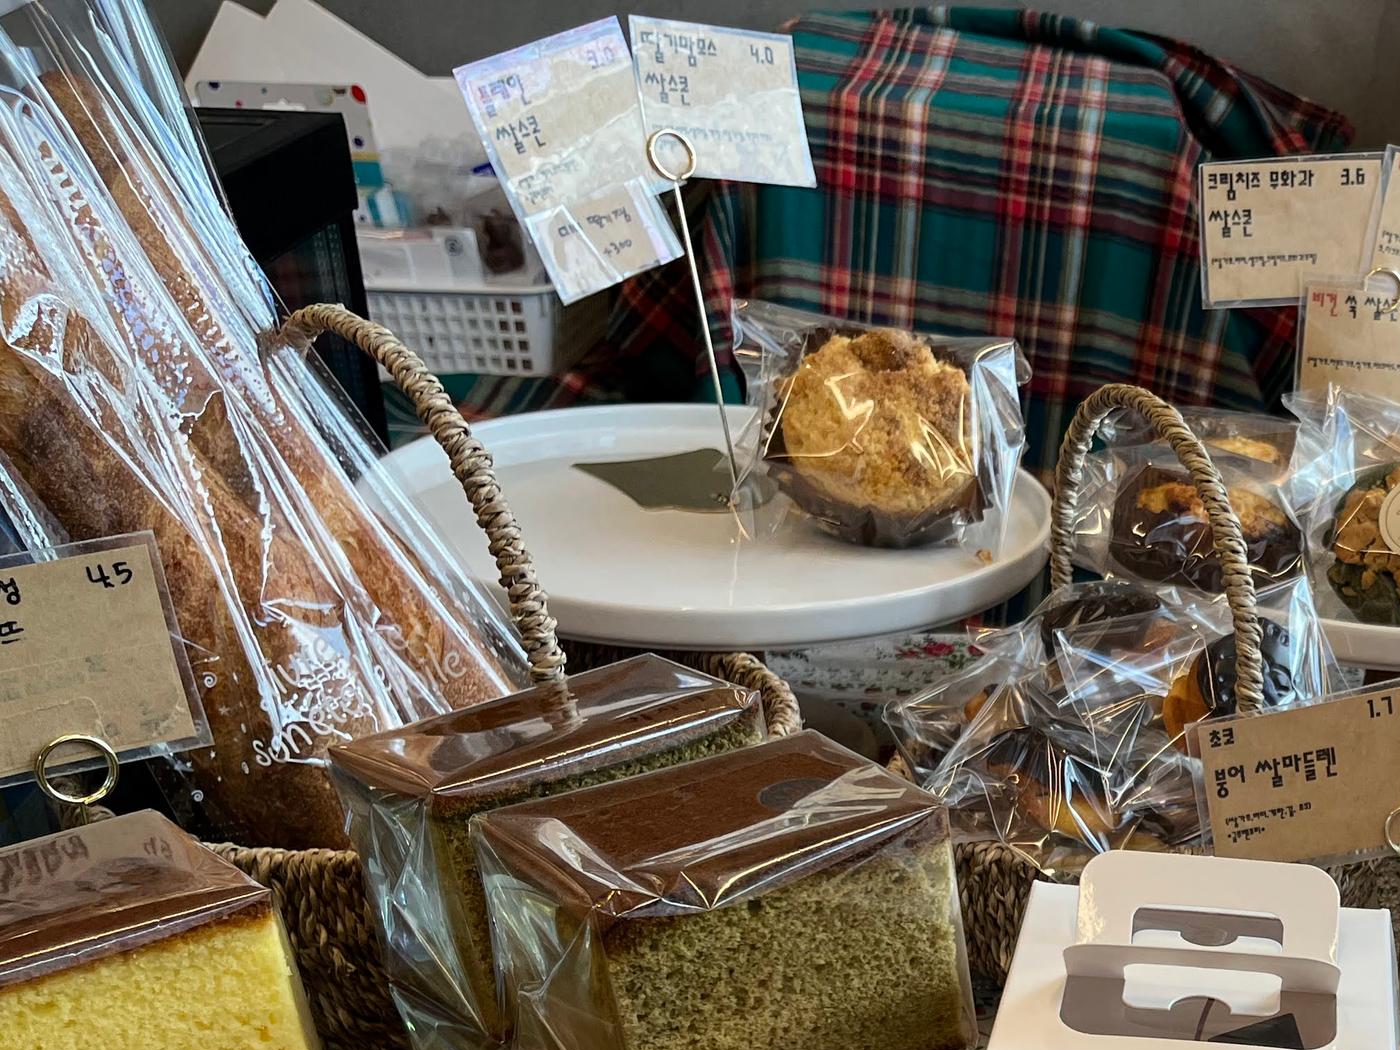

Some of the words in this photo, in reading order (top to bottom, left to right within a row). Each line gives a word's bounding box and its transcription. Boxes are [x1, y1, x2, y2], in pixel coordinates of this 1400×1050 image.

[749, 44, 775, 65] 4.0
[645, 72, 690, 106] 쌀스콘
[496, 115, 547, 154] 쌀스콘
[1208, 171, 1260, 201] 크림치즈
[1270, 169, 1314, 190] 무화과
[1340, 168, 1365, 186] 3.6
[1208, 209, 1252, 238] 쌀스콘
[1312, 292, 1338, 317] 비건
[1366, 696, 1393, 718] 1.7
[1208, 727, 1235, 748] 초코
[1214, 765, 1245, 799] 붕어
[1254, 747, 1338, 788] 쌀마들렌
